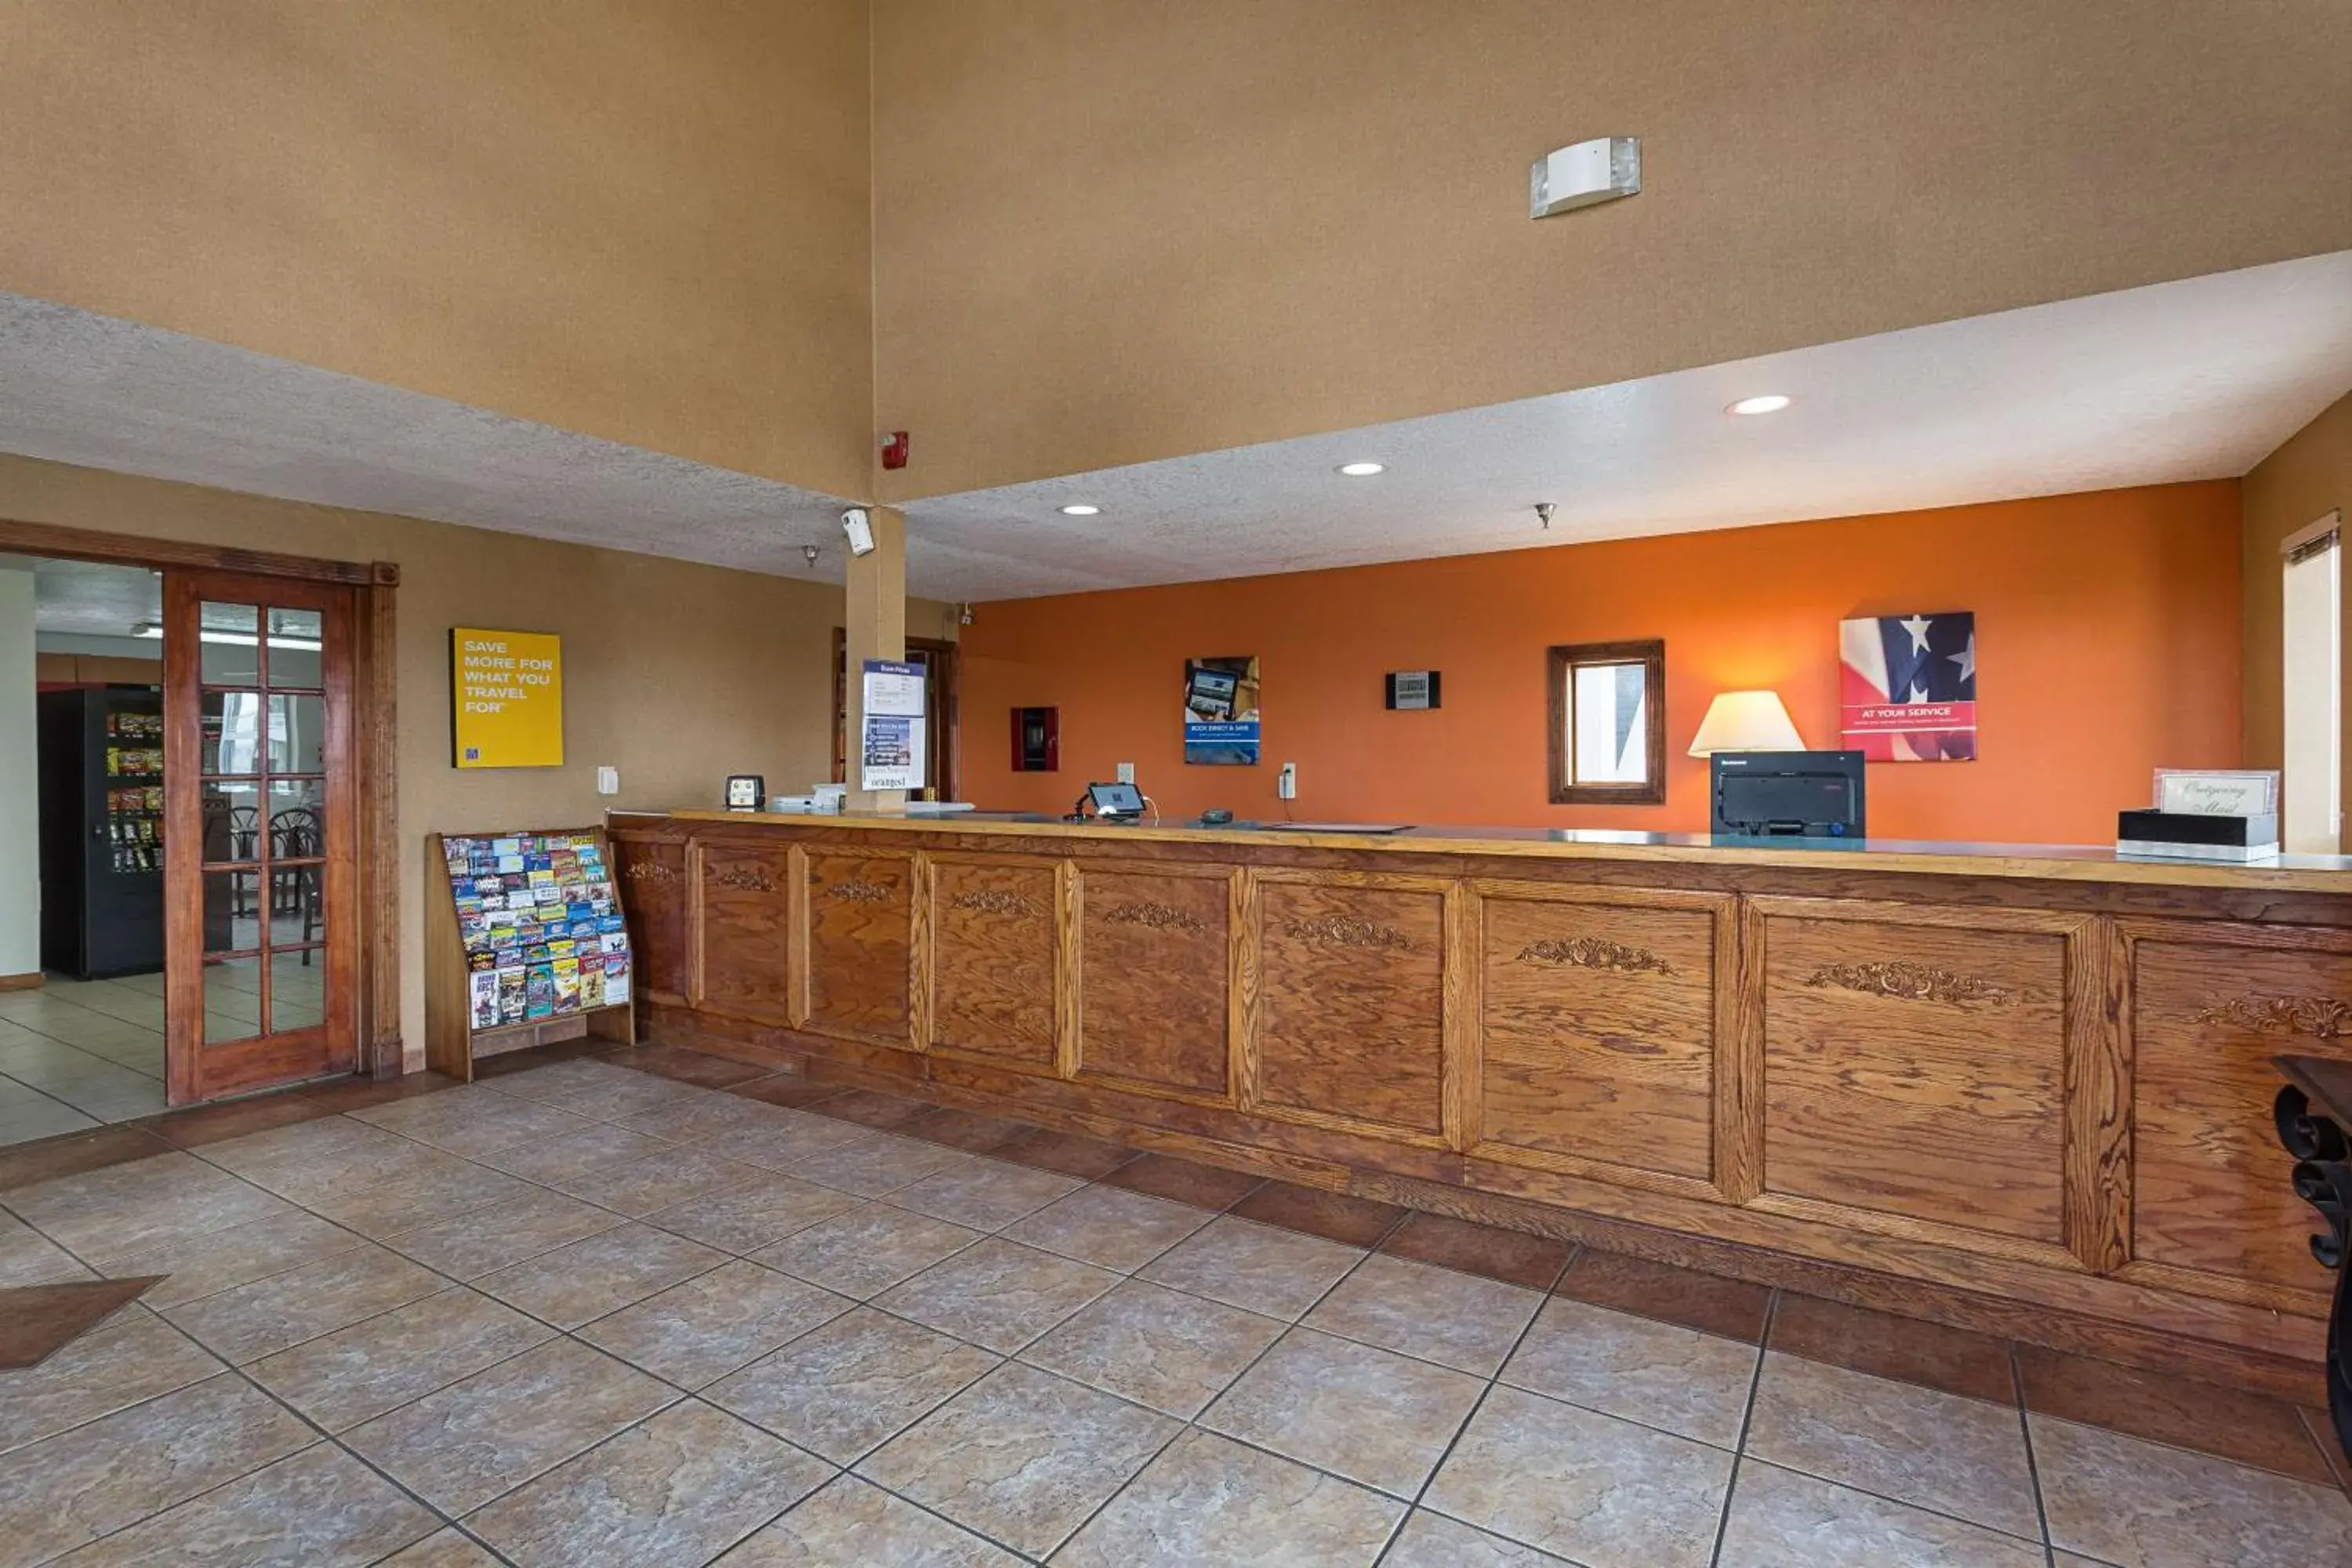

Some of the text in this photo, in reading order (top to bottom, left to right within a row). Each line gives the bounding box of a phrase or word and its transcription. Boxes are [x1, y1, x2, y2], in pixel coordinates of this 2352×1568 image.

[464, 641, 506, 653] SAVE
[464, 656, 553, 670] MORE FOR
[464, 672, 550, 684] WHAT YOU
[464, 686, 527, 699] TRAVEL
[1862, 706, 1951, 718] AT YOUR SERVICE
[2183, 781, 2247, 799] Outgoing
[2193, 800, 2240, 813] Mail
